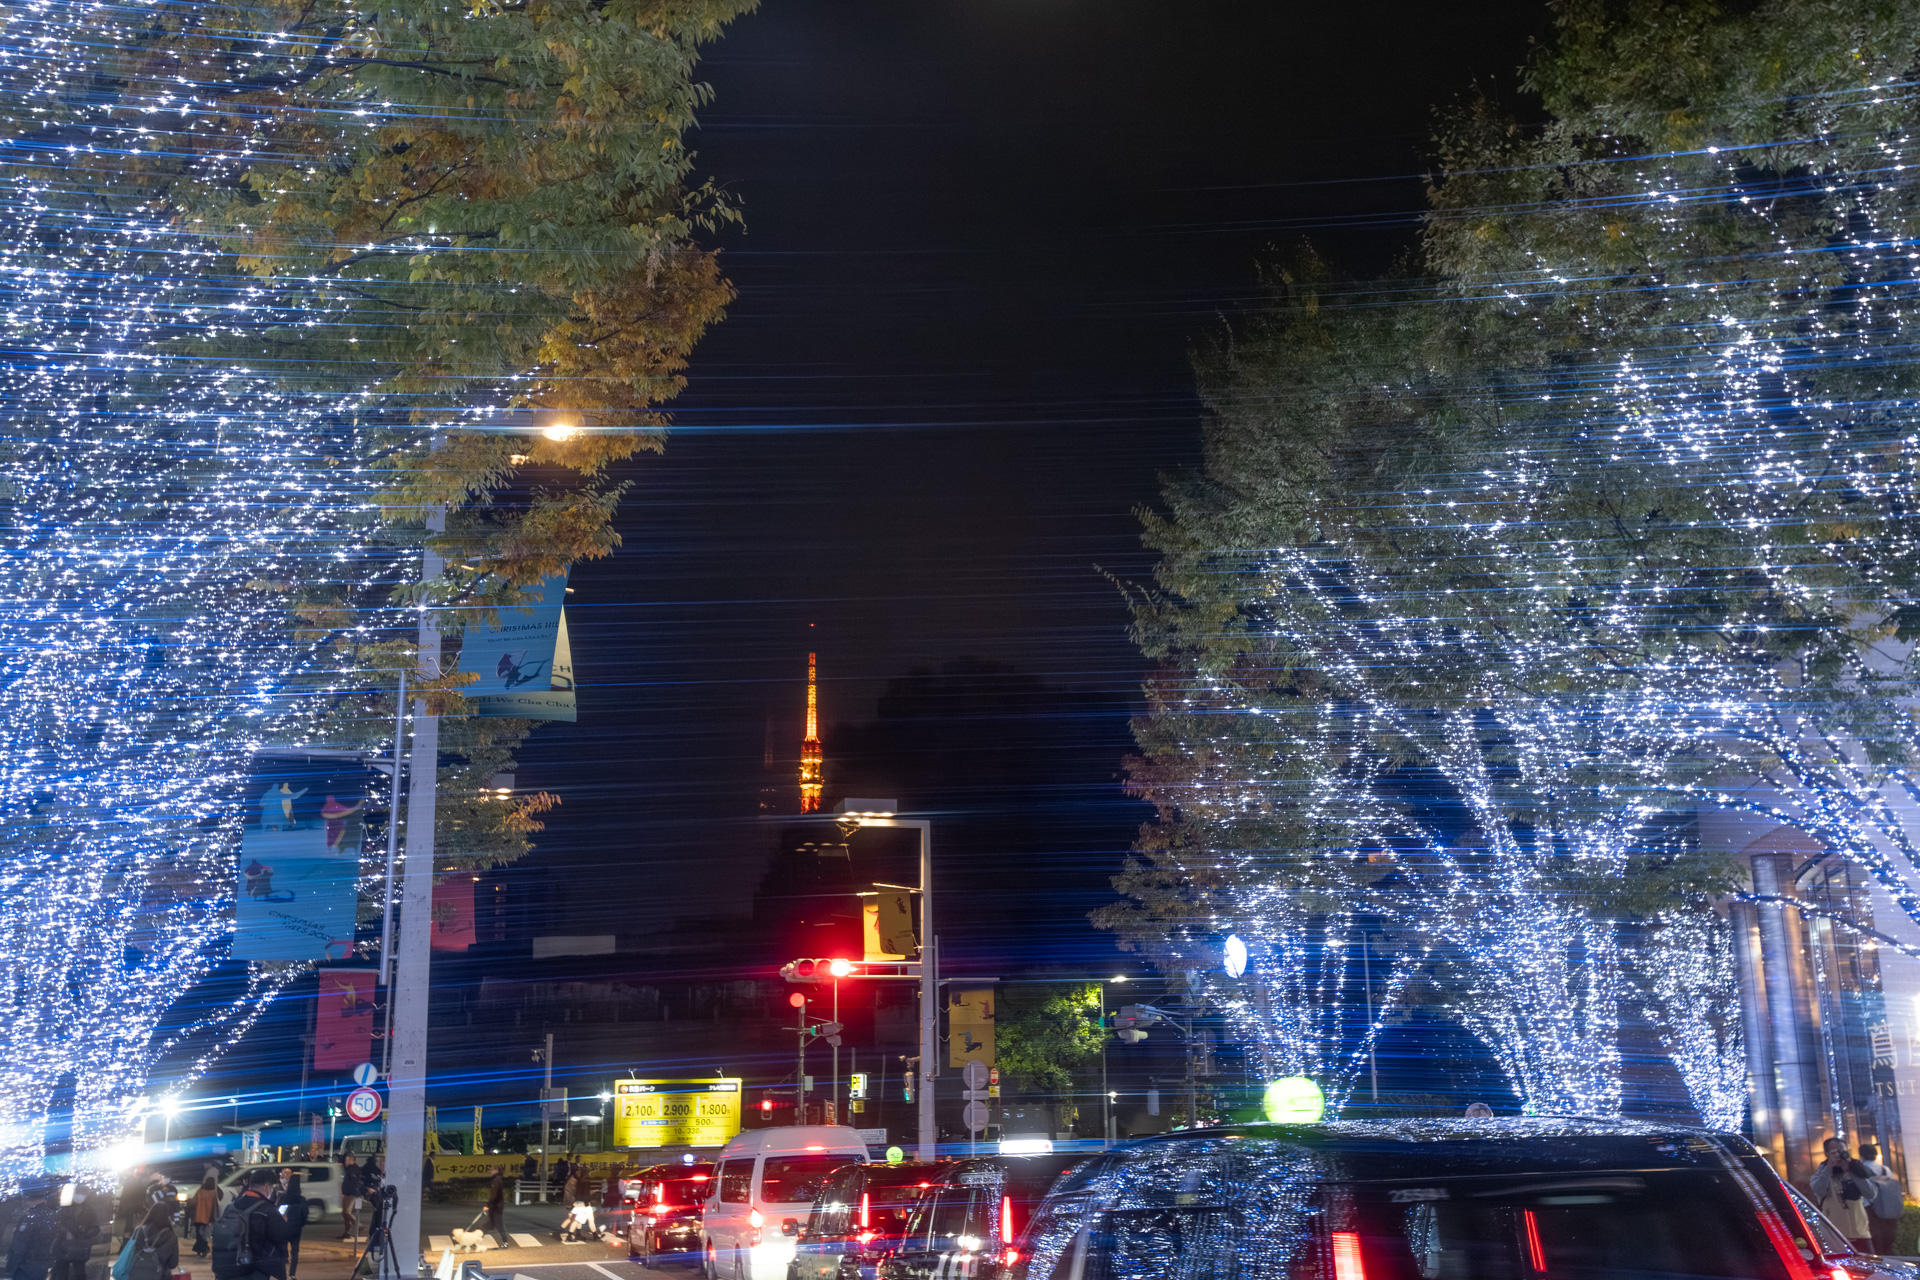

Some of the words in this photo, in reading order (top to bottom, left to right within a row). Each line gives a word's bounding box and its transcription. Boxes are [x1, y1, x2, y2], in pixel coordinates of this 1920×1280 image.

[518, 698, 542, 706] Cha
[546, 700, 570, 709] Cha
[354, 1097, 374, 1113] 50
